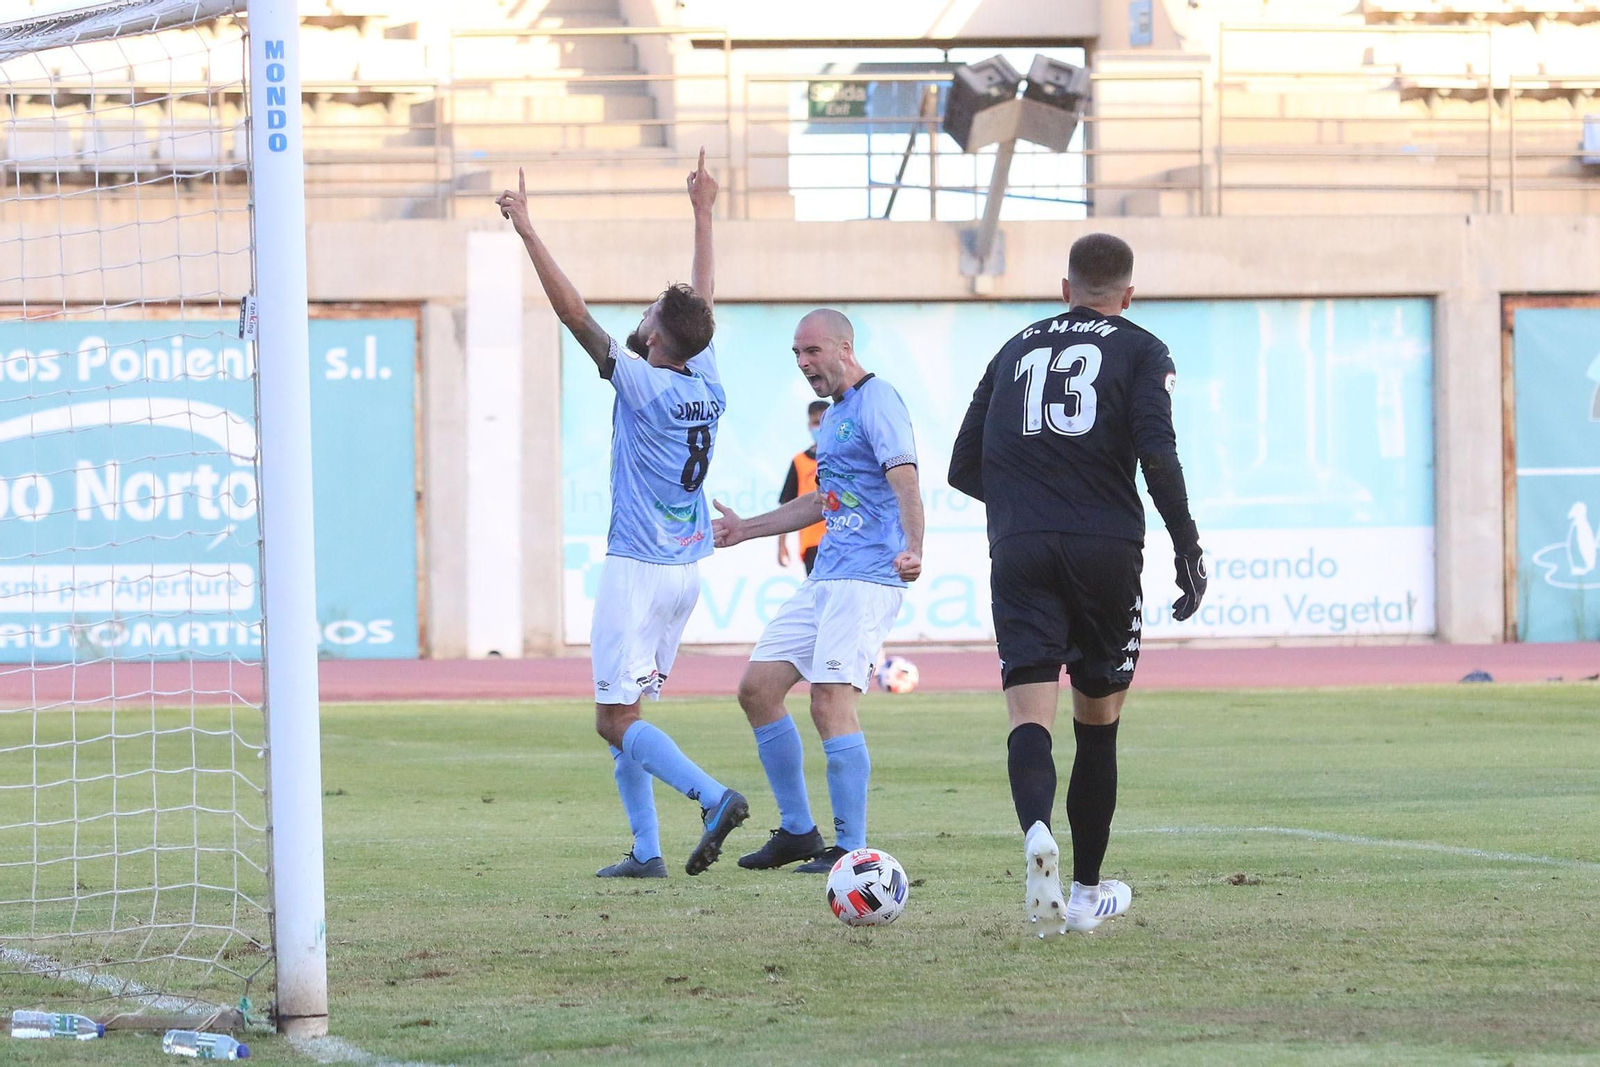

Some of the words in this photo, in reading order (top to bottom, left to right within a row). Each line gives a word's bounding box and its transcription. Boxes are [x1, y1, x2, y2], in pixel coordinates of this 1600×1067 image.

[265, 39, 288, 152] MONDO
[247, 302, 258, 335] ranking
[0, 348, 61, 382] os
[325, 335, 393, 380] s.l.
[1014, 343, 1103, 437] 13
[680, 425, 710, 493] 8
[1204, 546, 1338, 580] reando
[114, 573, 240, 604] Aperture
[1284, 590, 1415, 632] Vegetal
